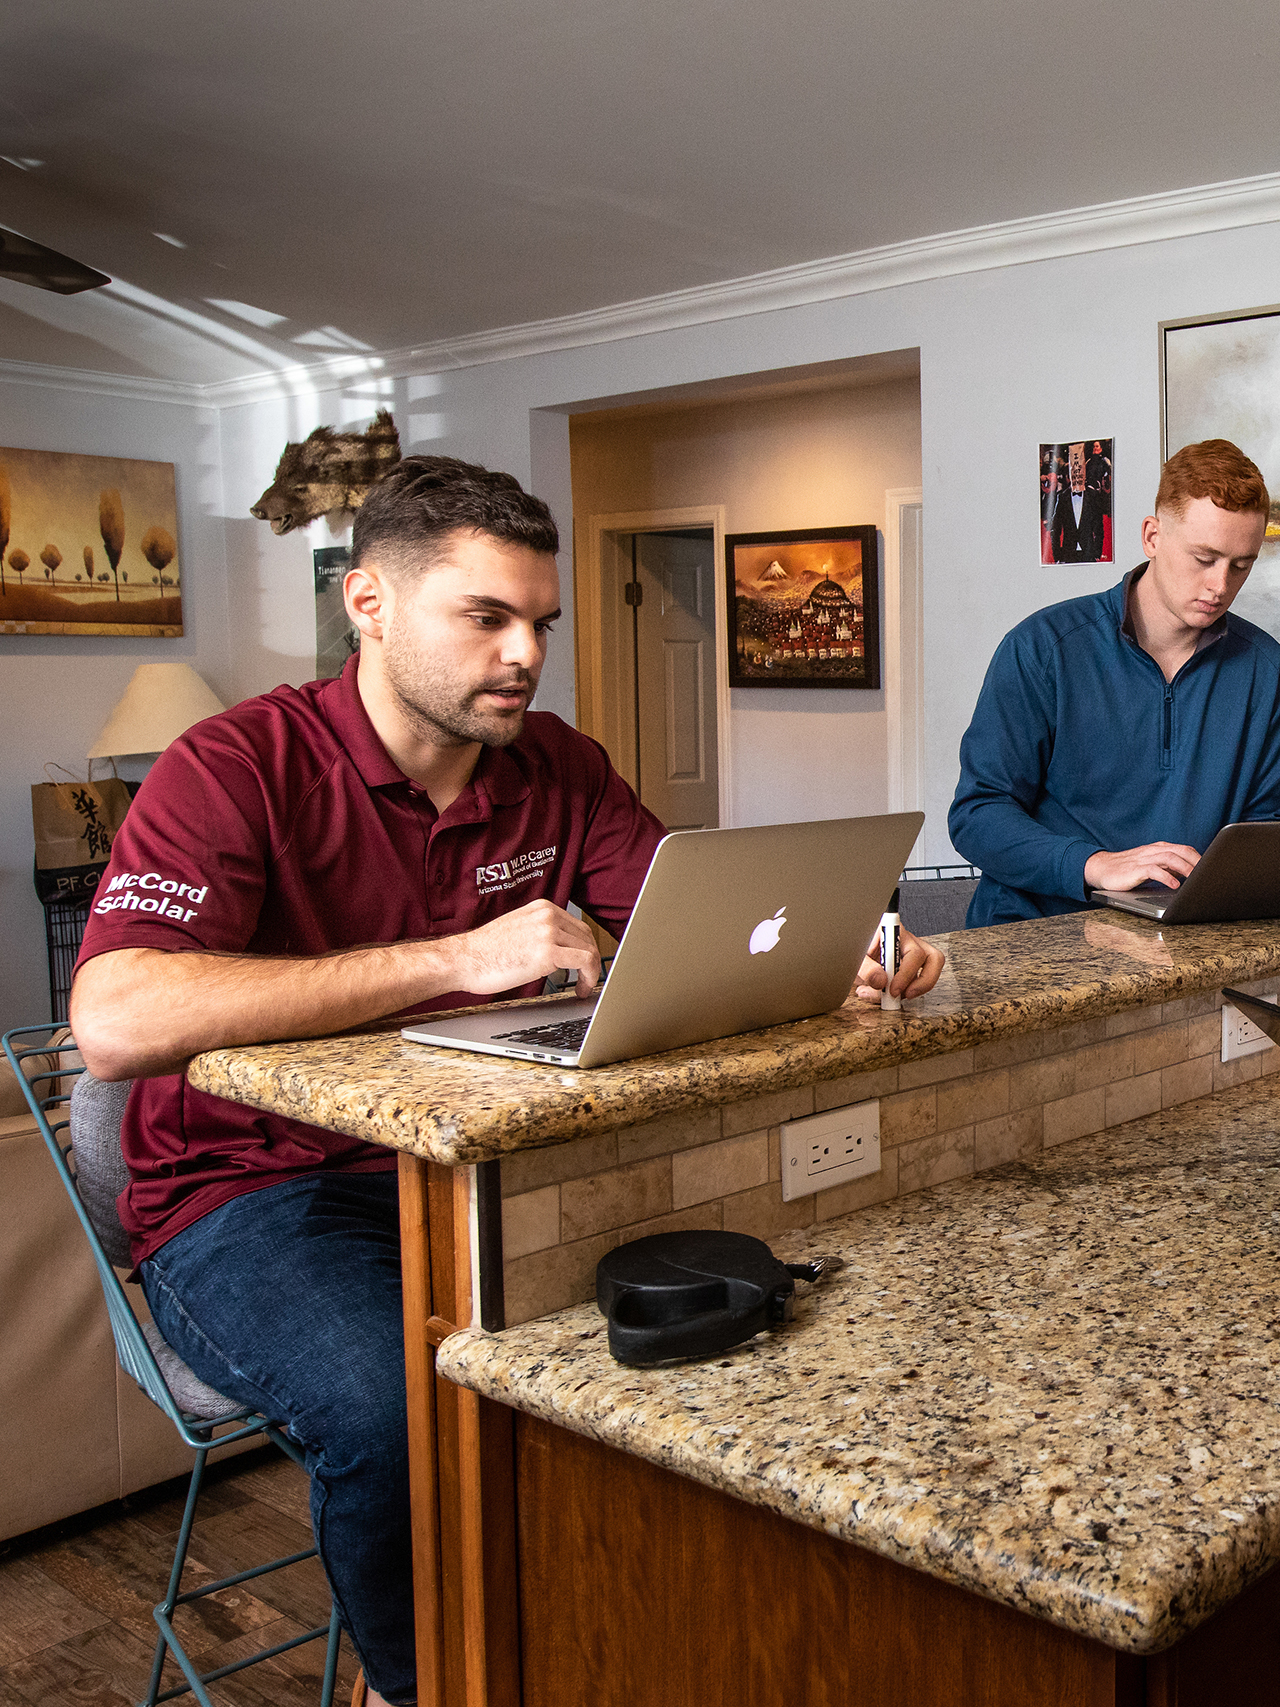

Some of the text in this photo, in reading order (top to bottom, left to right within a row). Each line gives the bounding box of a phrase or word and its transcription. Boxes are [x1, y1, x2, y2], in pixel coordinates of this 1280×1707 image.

[528, 845, 556, 862] Carey
[475, 861, 512, 885] ASU
[104, 872, 209, 904] McCord
[93, 890, 198, 923] Scholar
